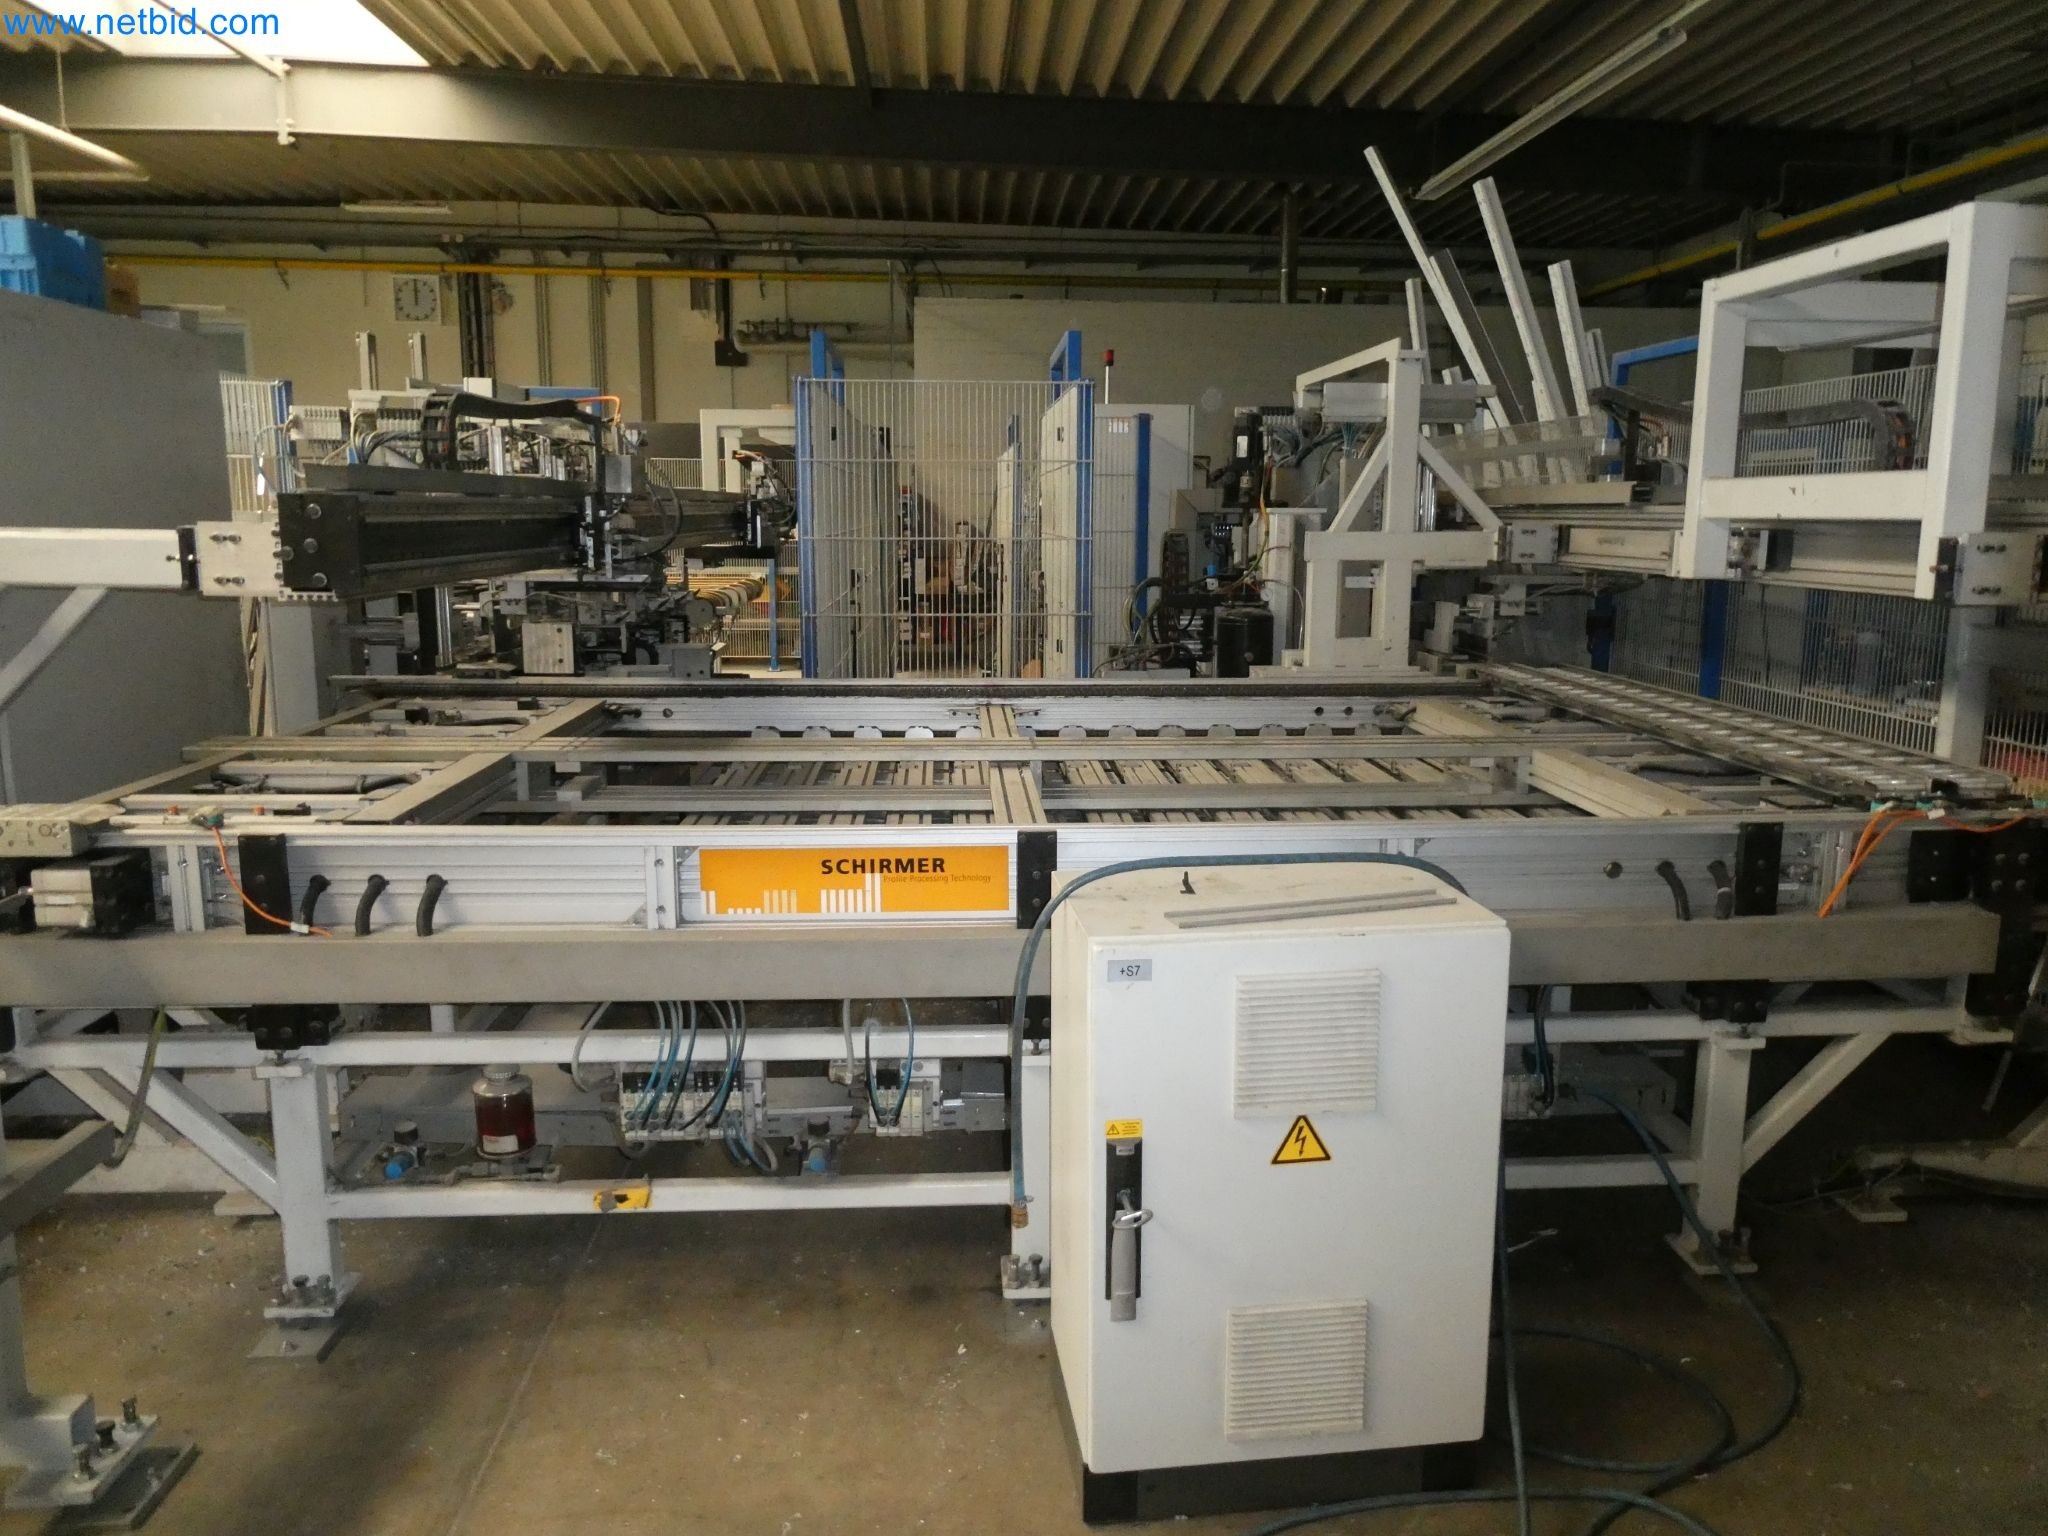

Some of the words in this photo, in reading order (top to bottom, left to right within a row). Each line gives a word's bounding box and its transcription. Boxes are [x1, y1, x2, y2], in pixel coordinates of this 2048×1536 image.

[821, 857, 946, 875] SCHIRMER
[883, 875, 908, 884] Profile
[909, 874, 949, 884] Processing
[951, 874, 992, 883] Technology
[1119, 965, 1141, 977] +S7
